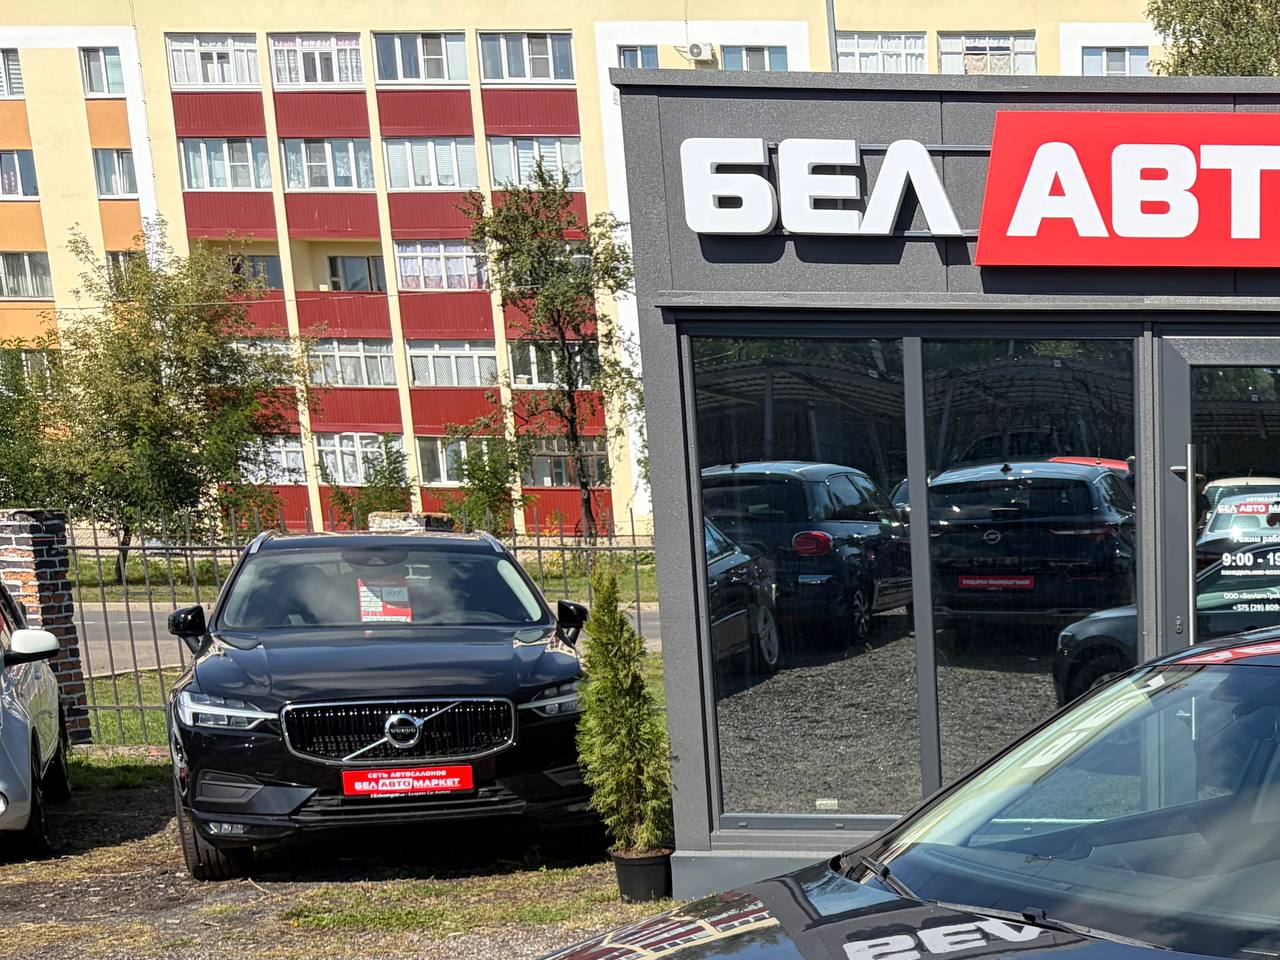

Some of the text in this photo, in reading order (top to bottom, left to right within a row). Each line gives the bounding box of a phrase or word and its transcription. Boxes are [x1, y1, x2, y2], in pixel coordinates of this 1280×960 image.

[679, 137, 963, 236] БЕЛ
[1238, 504, 1266, 513] АВТО
[1222, 552, 1254, 566] 9:00
[1250, 603, 1264, 612] (29)
[390, 770, 447, 778] АВТОСАЛОНОВ
[379, 779, 412, 789] АВТО
[413, 778, 461, 789] МАРКЕТ
